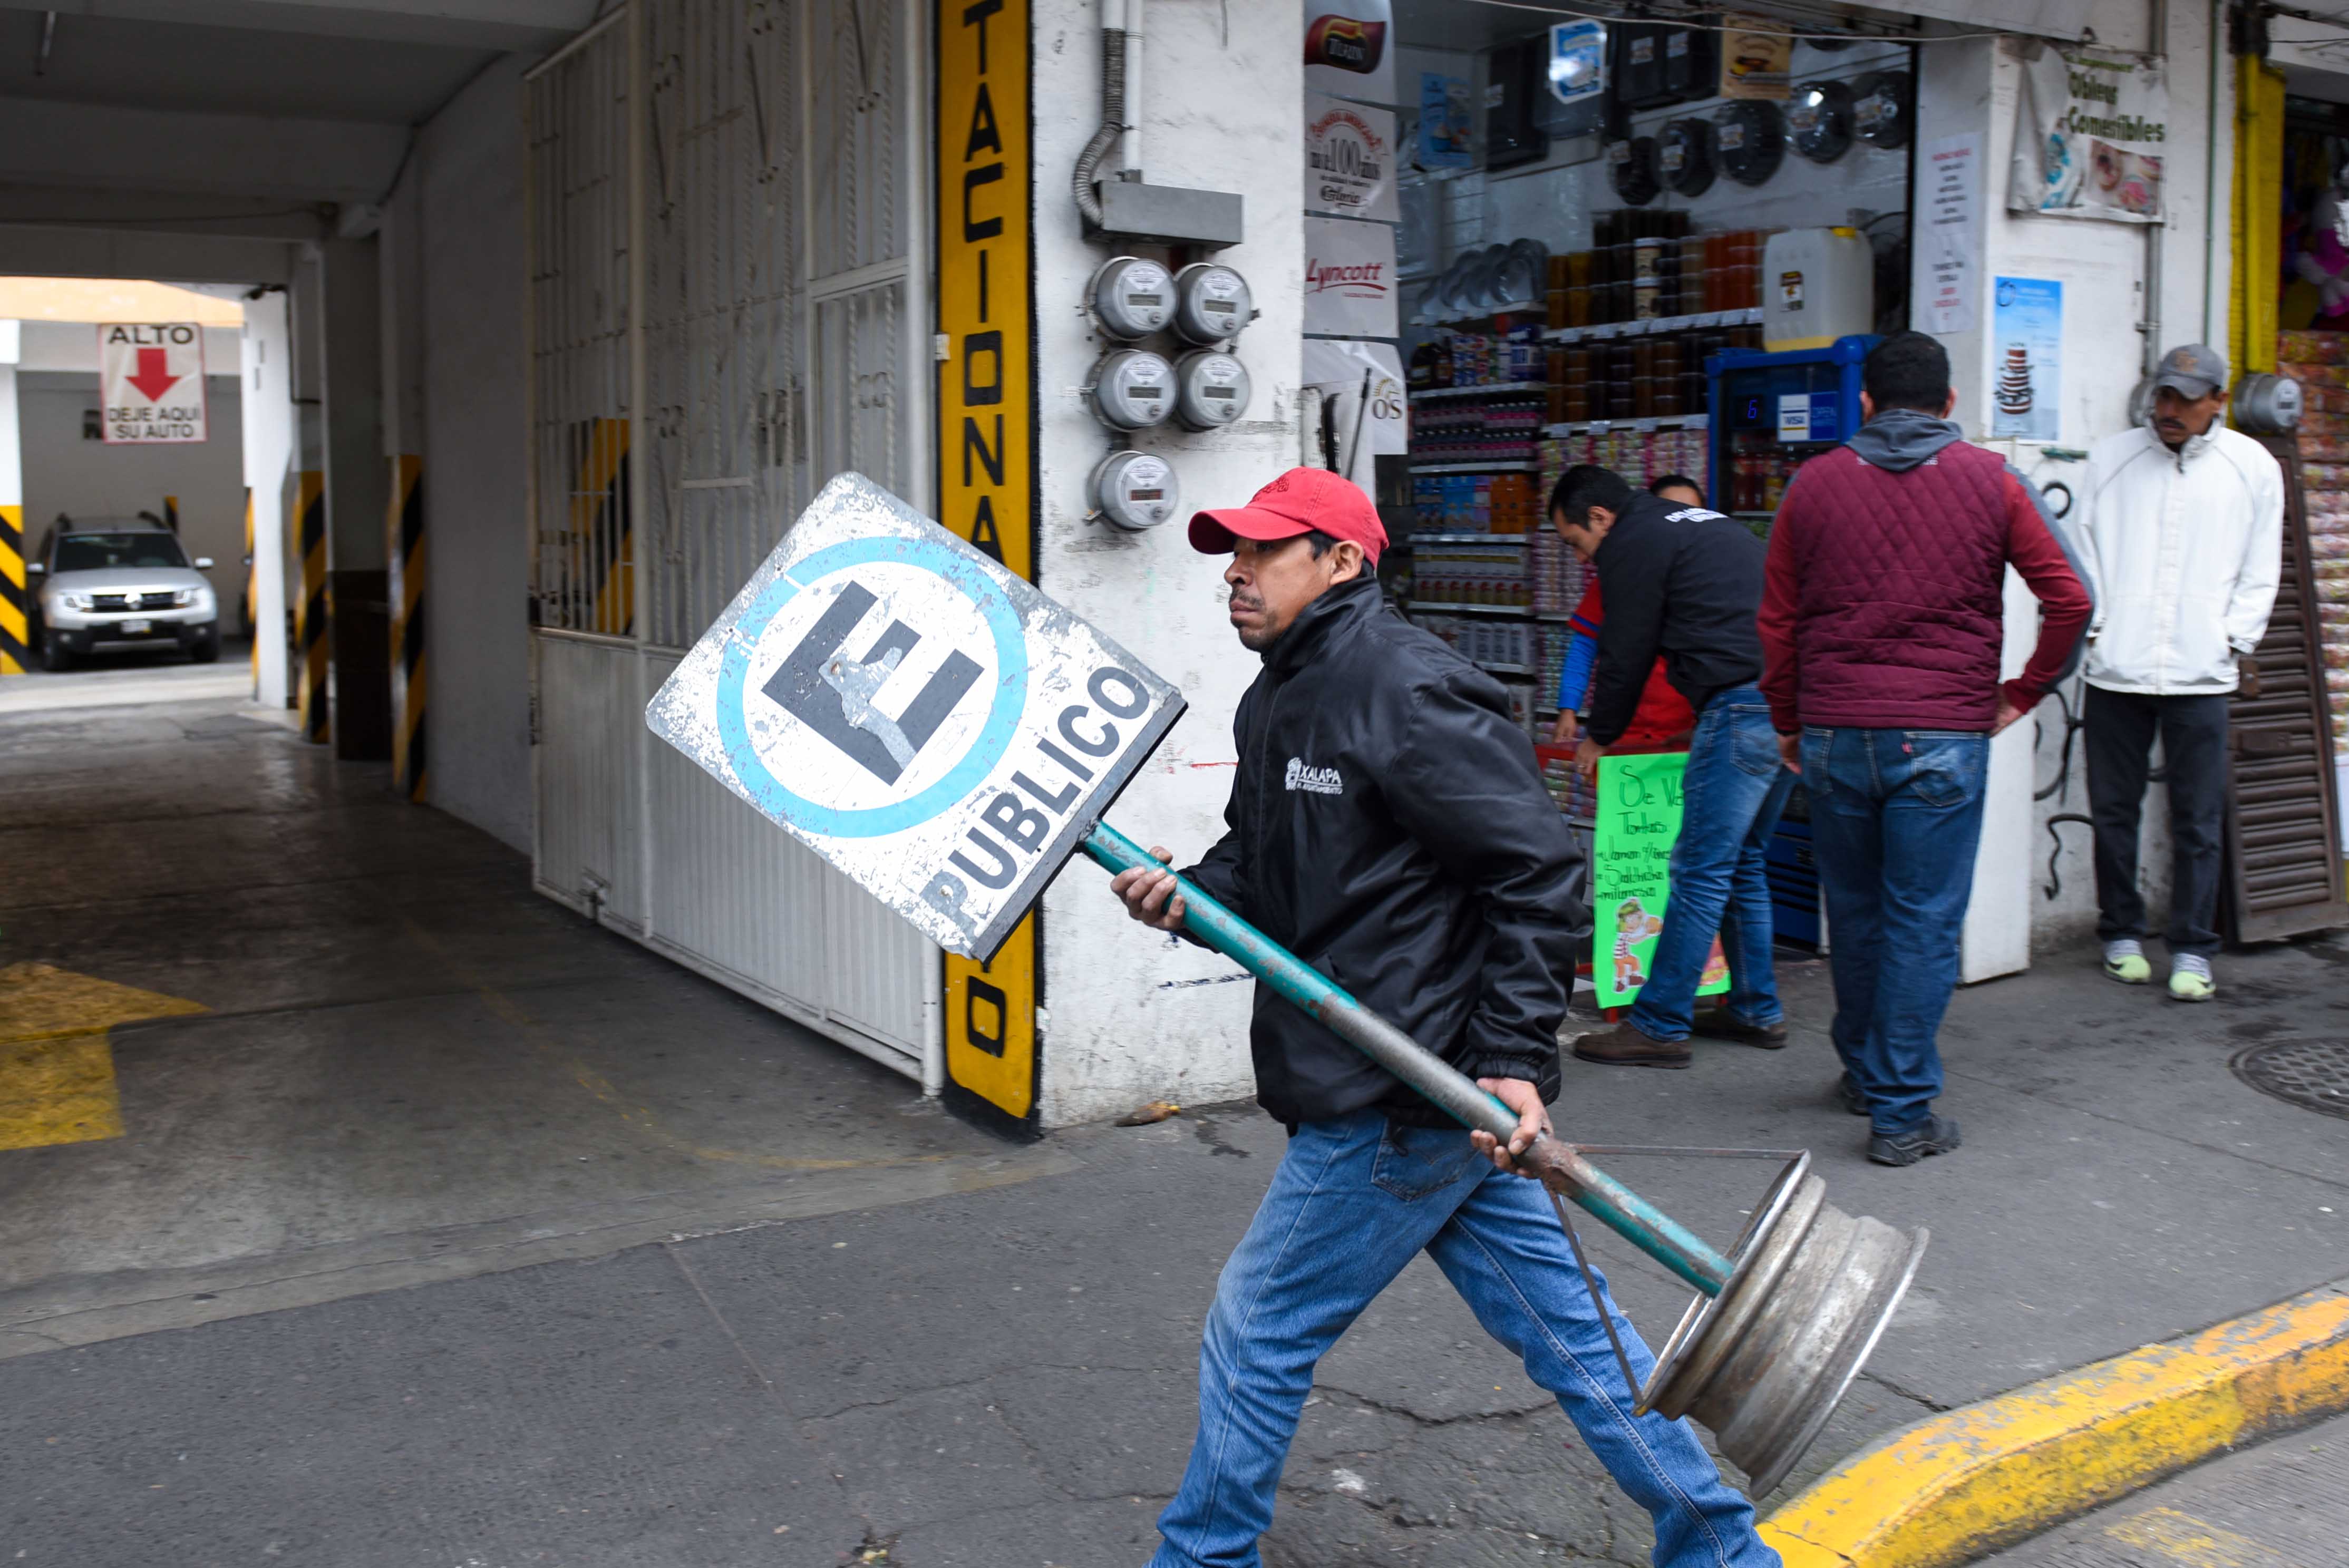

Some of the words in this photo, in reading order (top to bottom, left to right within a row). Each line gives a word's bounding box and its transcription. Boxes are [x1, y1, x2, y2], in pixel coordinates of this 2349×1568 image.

[1305, 257, 1383, 294] Lyncott
[108, 326, 193, 345] ALTO
[109, 407, 152, 422] DEJE
[115, 424, 140, 439] SU
[145, 423, 194, 439] AUTO
[761, 580, 984, 786] E
[1300, 765, 1342, 784] XALAPA
[920, 666, 1149, 930] PUBLICO
